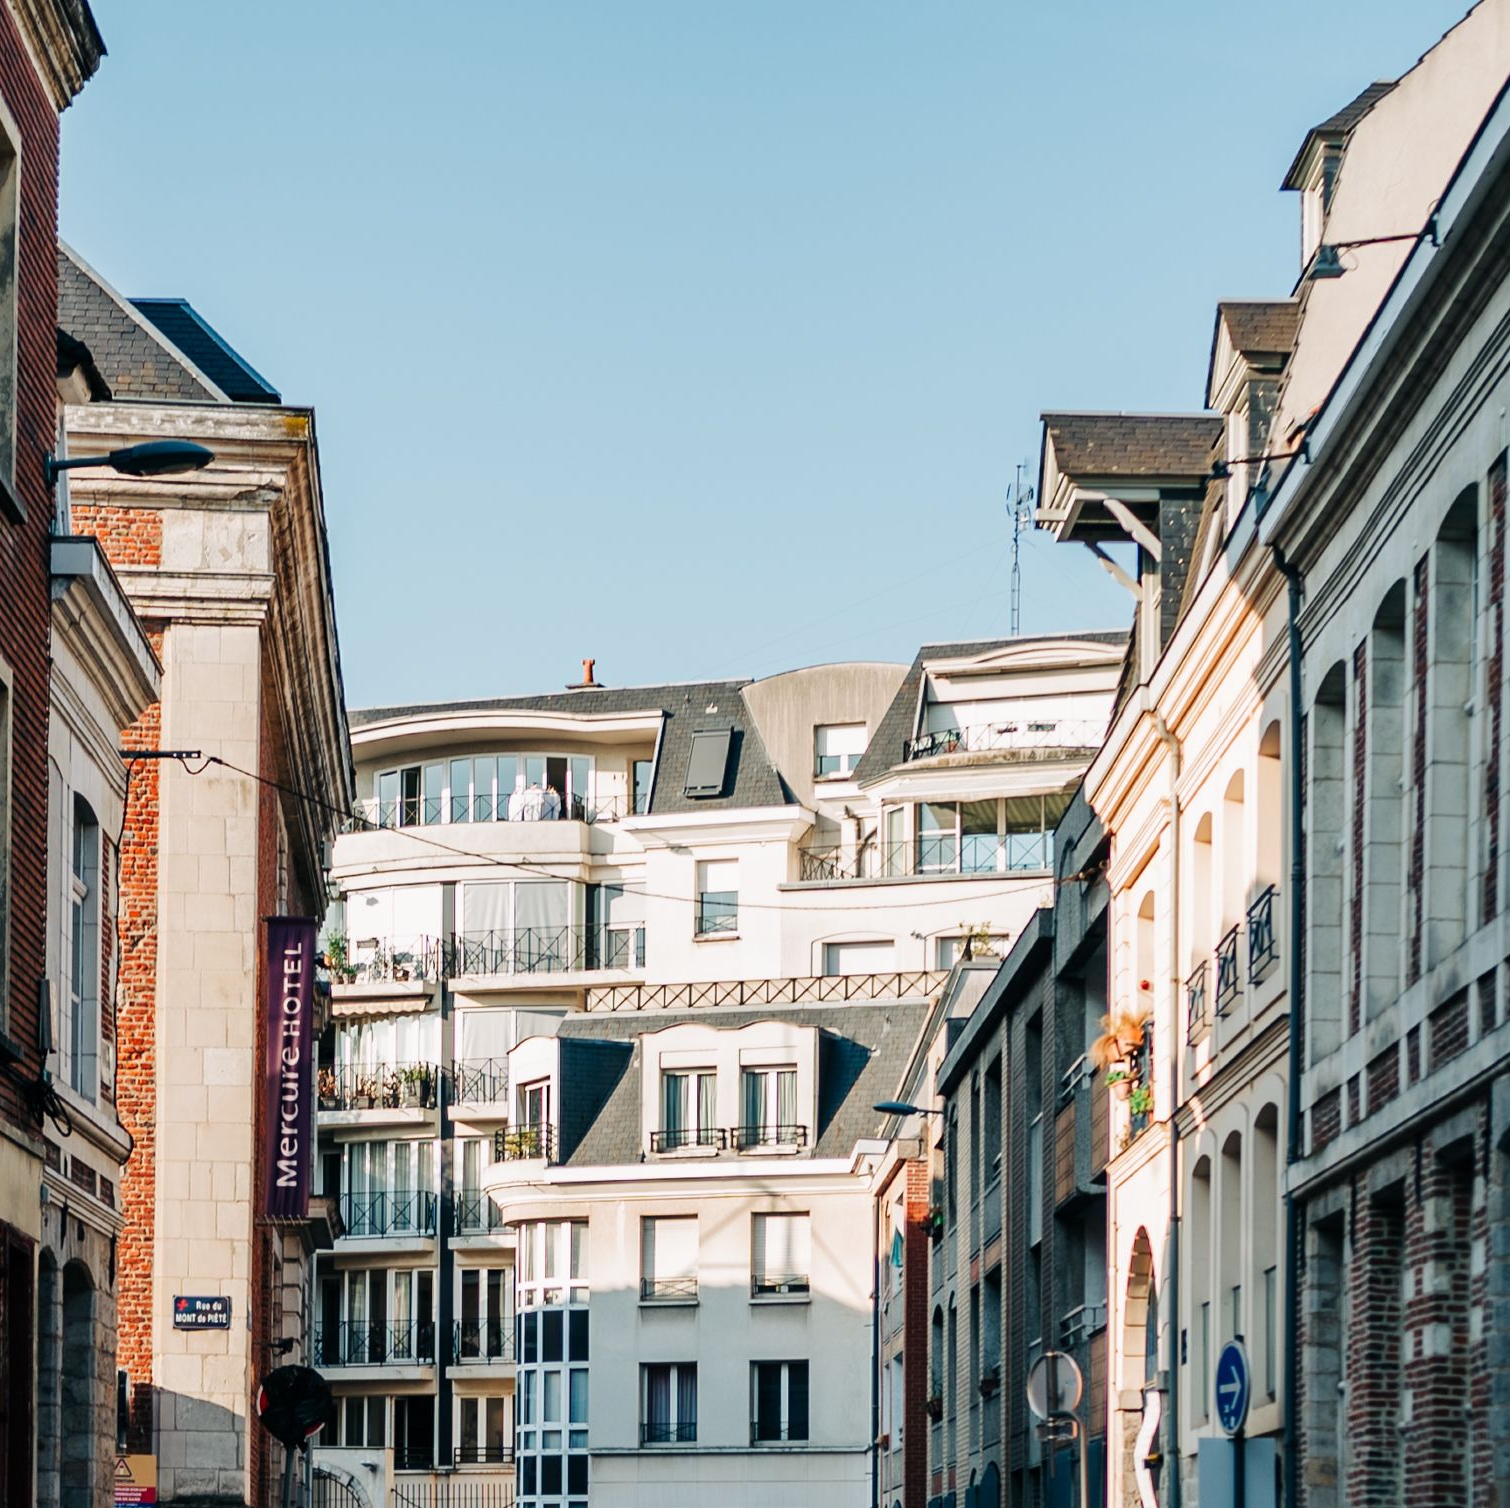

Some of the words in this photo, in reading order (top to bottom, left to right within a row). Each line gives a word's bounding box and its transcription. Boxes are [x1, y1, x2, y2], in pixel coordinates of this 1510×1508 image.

[283, 942, 302, 1036] HOTEL
[276, 1046, 300, 1187] Mercure
[175, 1313, 197, 1323] MONT
[197, 1313, 207, 1323] de
[196, 1300, 211, 1310] Rue
[212, 1301, 222, 1310] du
